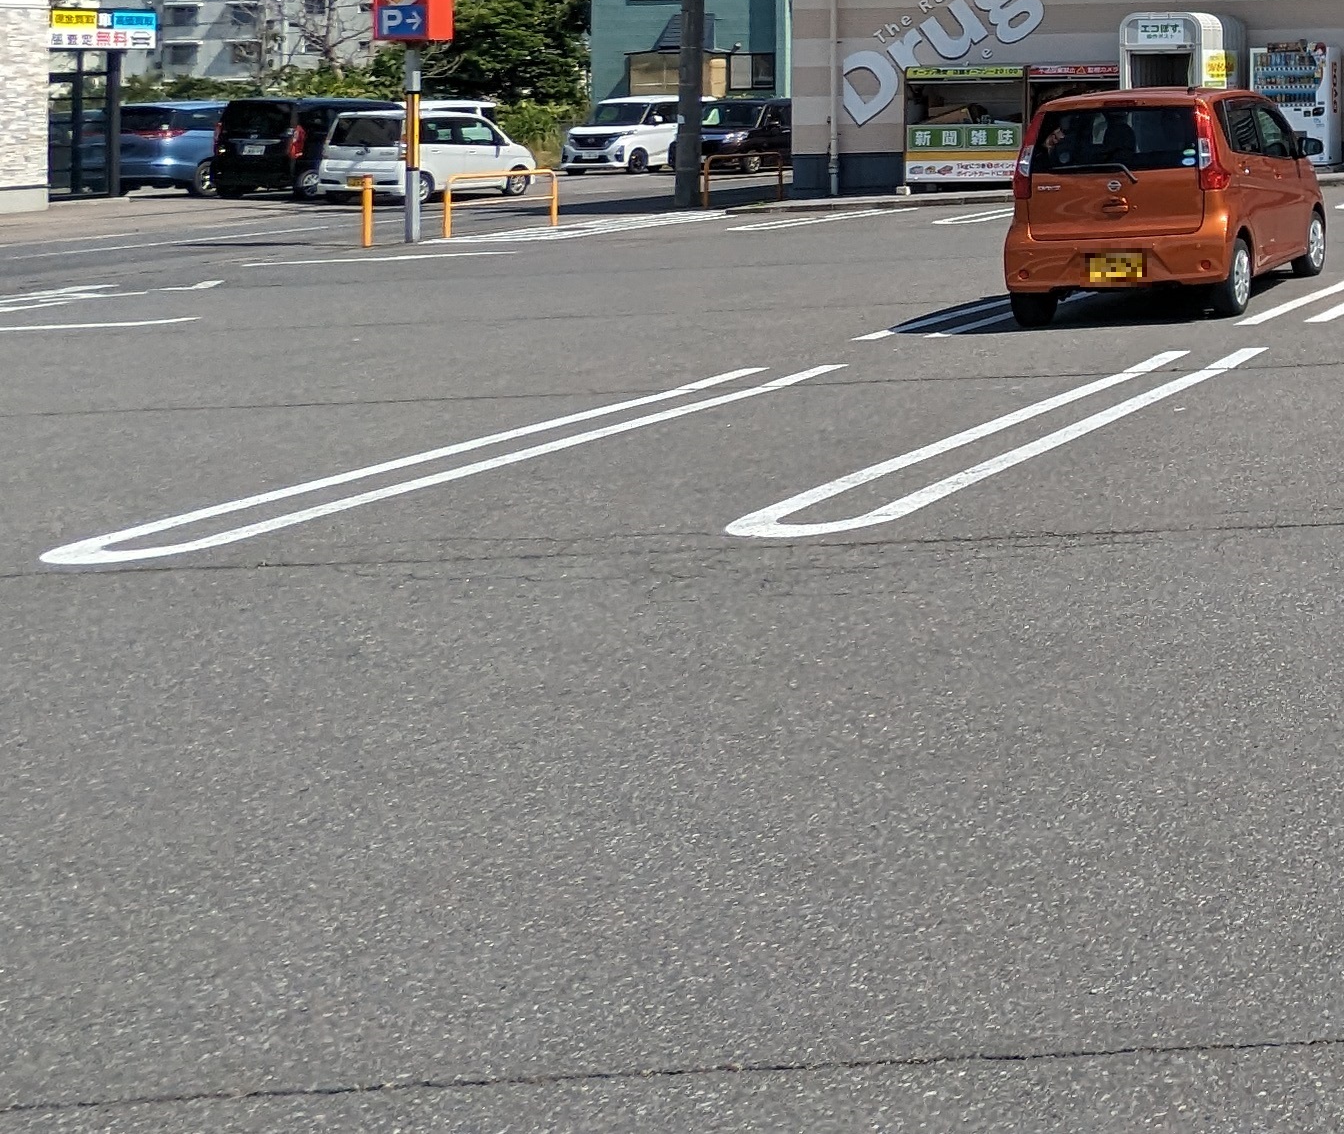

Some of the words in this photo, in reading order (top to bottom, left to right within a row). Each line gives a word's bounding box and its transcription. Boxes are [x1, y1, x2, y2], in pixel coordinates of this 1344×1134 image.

[382, 9, 403, 35] P
[873, 15, 912, 43] The
[915, 130, 958, 146] 新聞
[971, 129, 1014, 145] 雑誌
